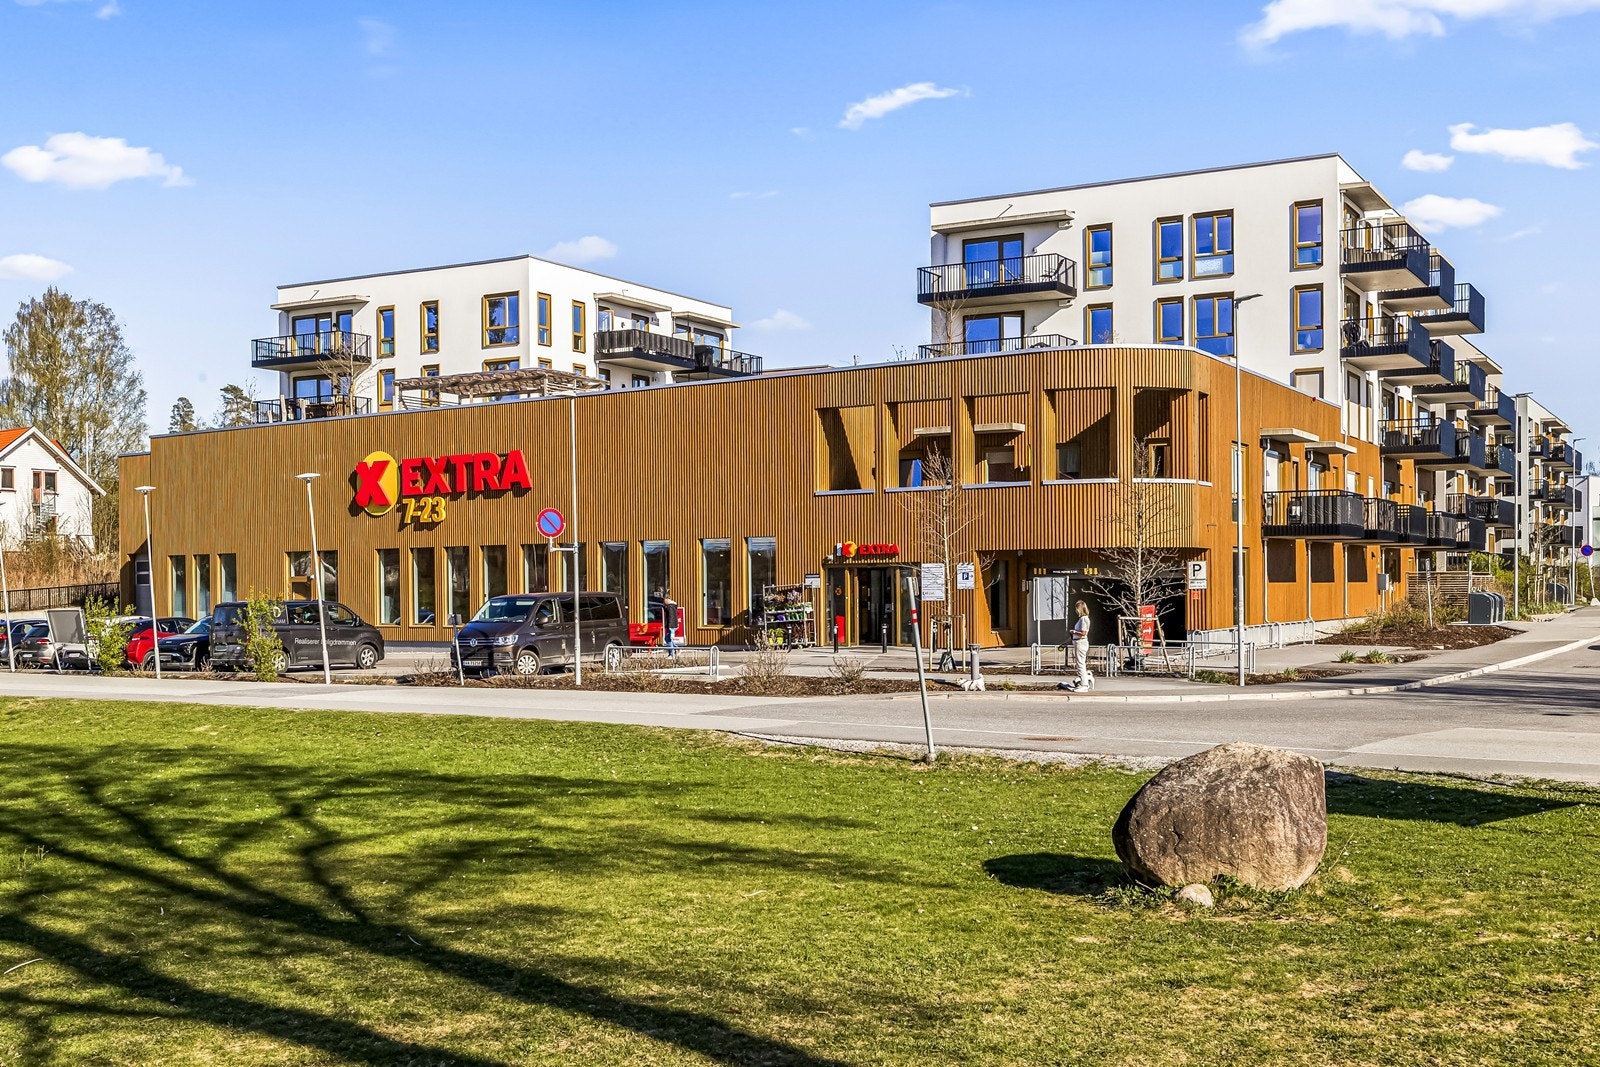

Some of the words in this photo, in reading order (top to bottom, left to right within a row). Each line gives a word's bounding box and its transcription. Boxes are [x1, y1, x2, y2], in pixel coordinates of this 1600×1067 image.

[401, 449, 533, 496] EXTRA
[402, 496, 446, 524] 7-23
[859, 543, 900, 555] EXTRA
[1192, 563, 1202, 577] P
